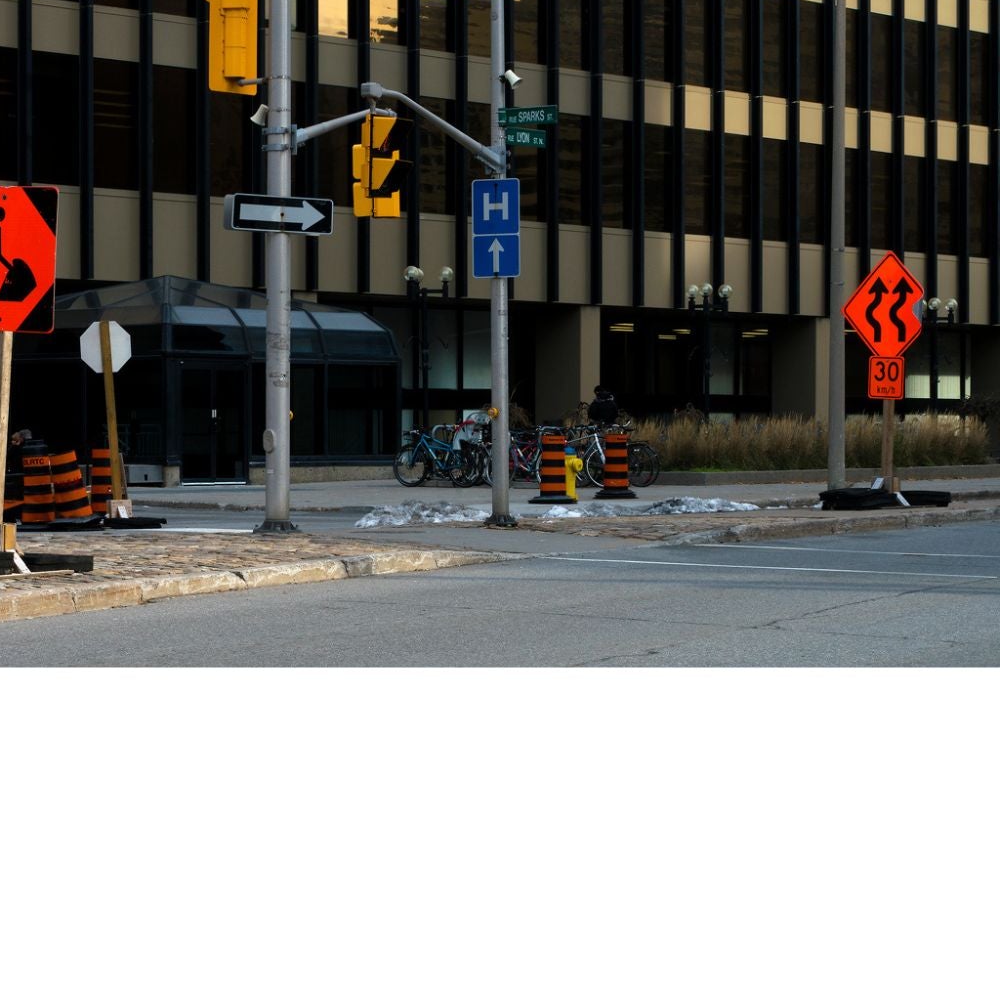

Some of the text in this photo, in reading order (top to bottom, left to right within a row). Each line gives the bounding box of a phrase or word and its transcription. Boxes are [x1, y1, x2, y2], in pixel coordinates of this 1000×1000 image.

[518, 110, 545, 122] SPARKS
[516, 131, 530, 143] LYON
[483, 192, 509, 220] H
[874, 361, 899, 382] 30
[877, 385, 896, 395] km/h
